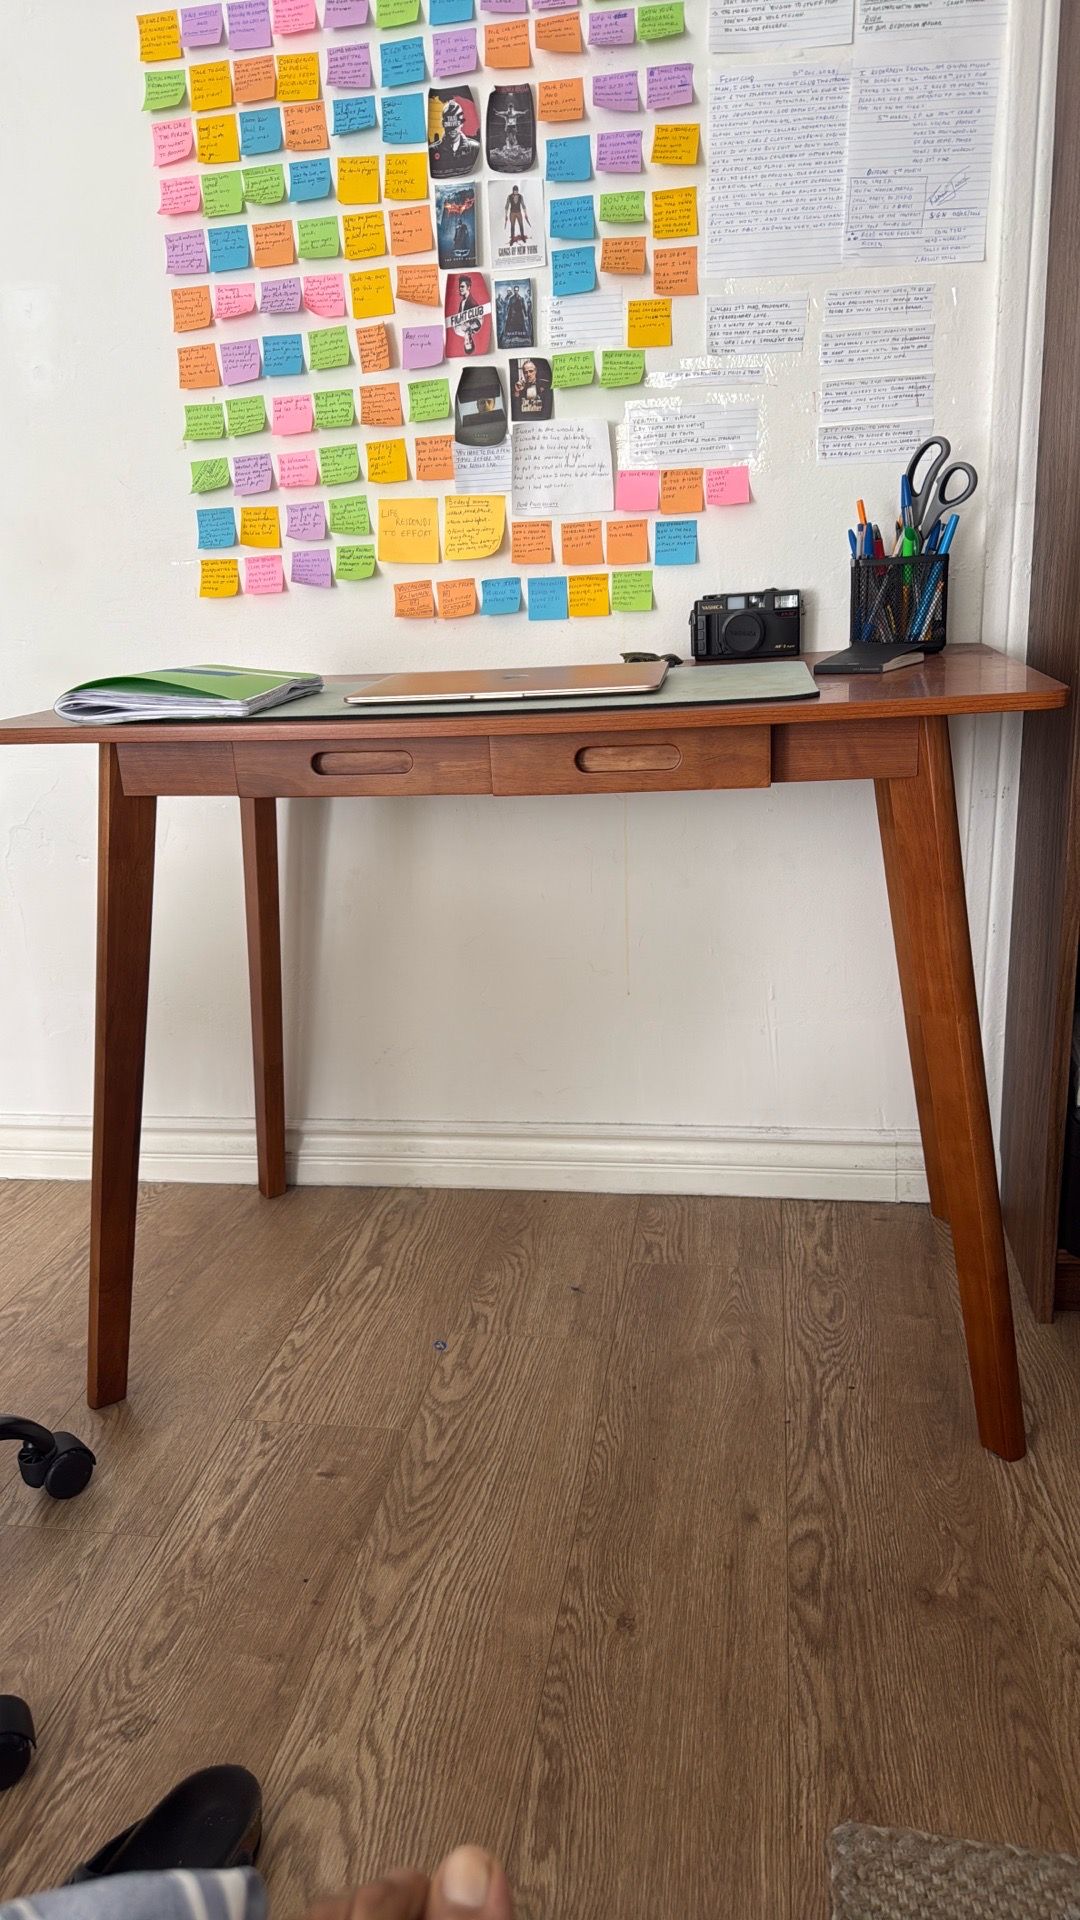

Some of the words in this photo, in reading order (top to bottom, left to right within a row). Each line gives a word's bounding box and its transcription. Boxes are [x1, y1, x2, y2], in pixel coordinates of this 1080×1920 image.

[517, 246, 526, 256] NEW
[527, 245, 538, 254] YORK
[451, 312, 467, 325] FIGHT
[468, 306, 484, 319] CLUB
[381, 509, 398, 518] LIFE
